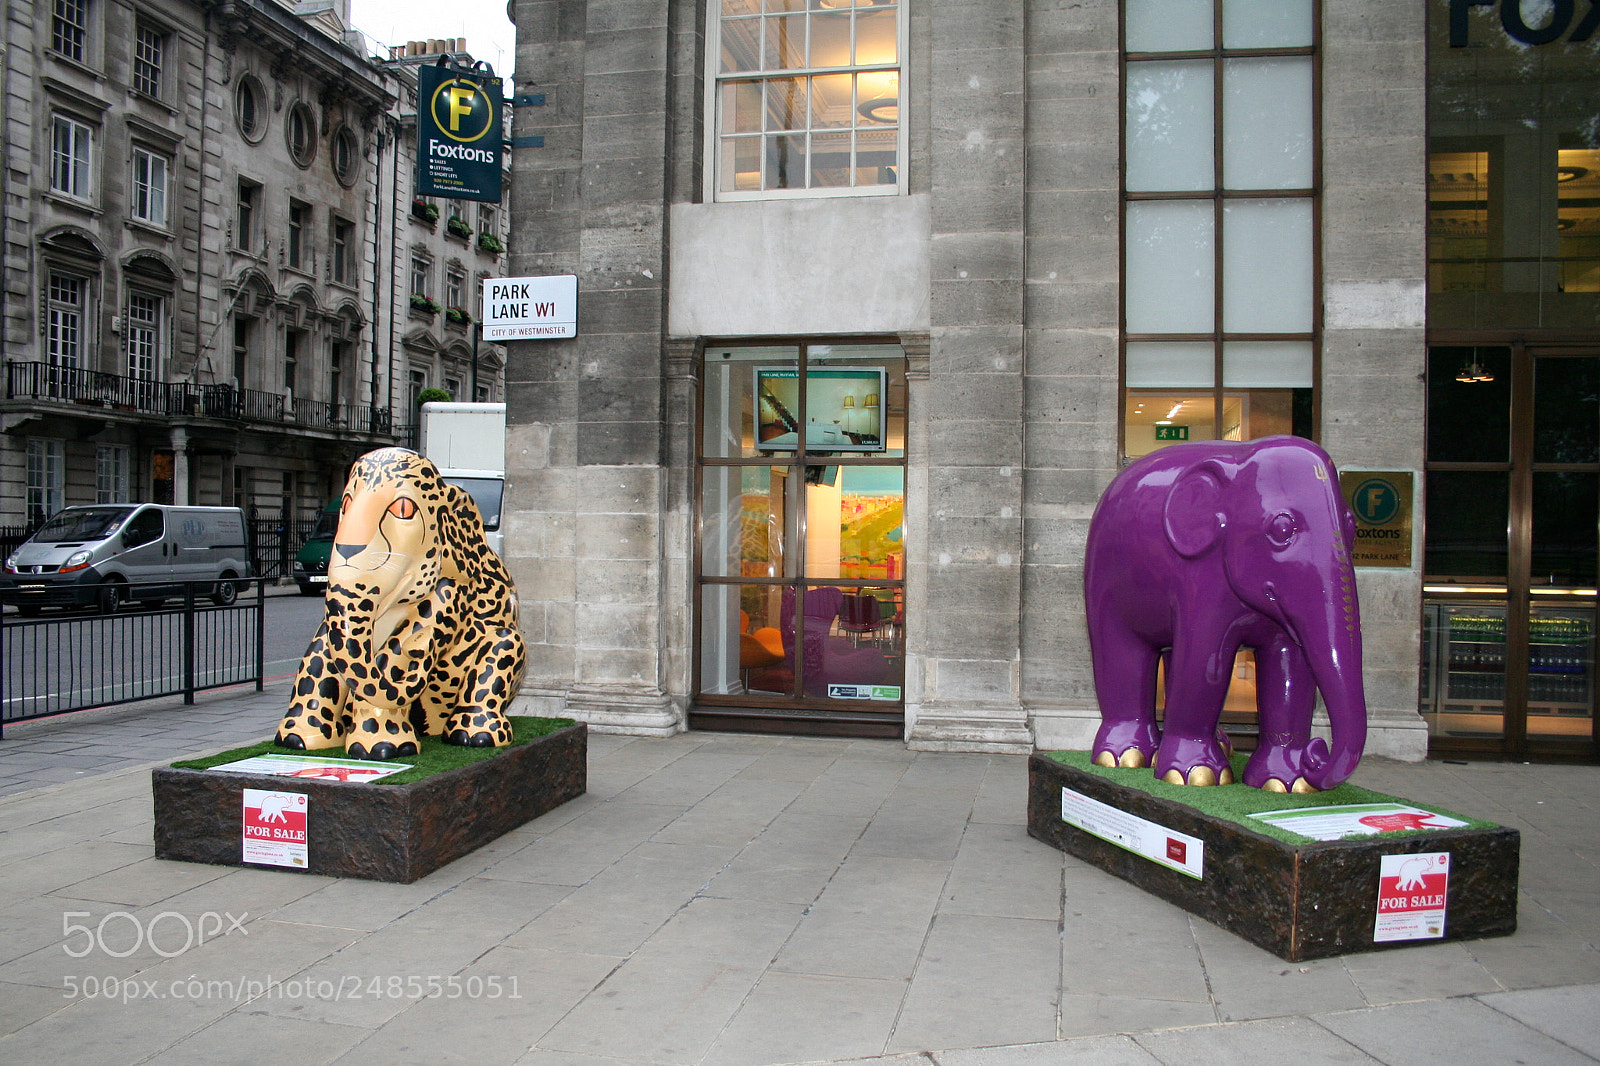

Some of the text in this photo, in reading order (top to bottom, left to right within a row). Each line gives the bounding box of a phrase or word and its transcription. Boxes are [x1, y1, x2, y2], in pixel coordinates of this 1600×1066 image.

[450, 87, 475, 131] F
[429, 138, 494, 164] Foxtons
[492, 284, 530, 300] PARK
[492, 302, 555, 319] LANE W1
[491, 326, 566, 337] CITY OF WESTMINSTER
[1367, 488, 1385, 517] F
[1355, 527, 1400, 539] oxtons
[246, 825, 305, 841] FOR SALE
[1380, 894, 1444, 909] FOR SALE
